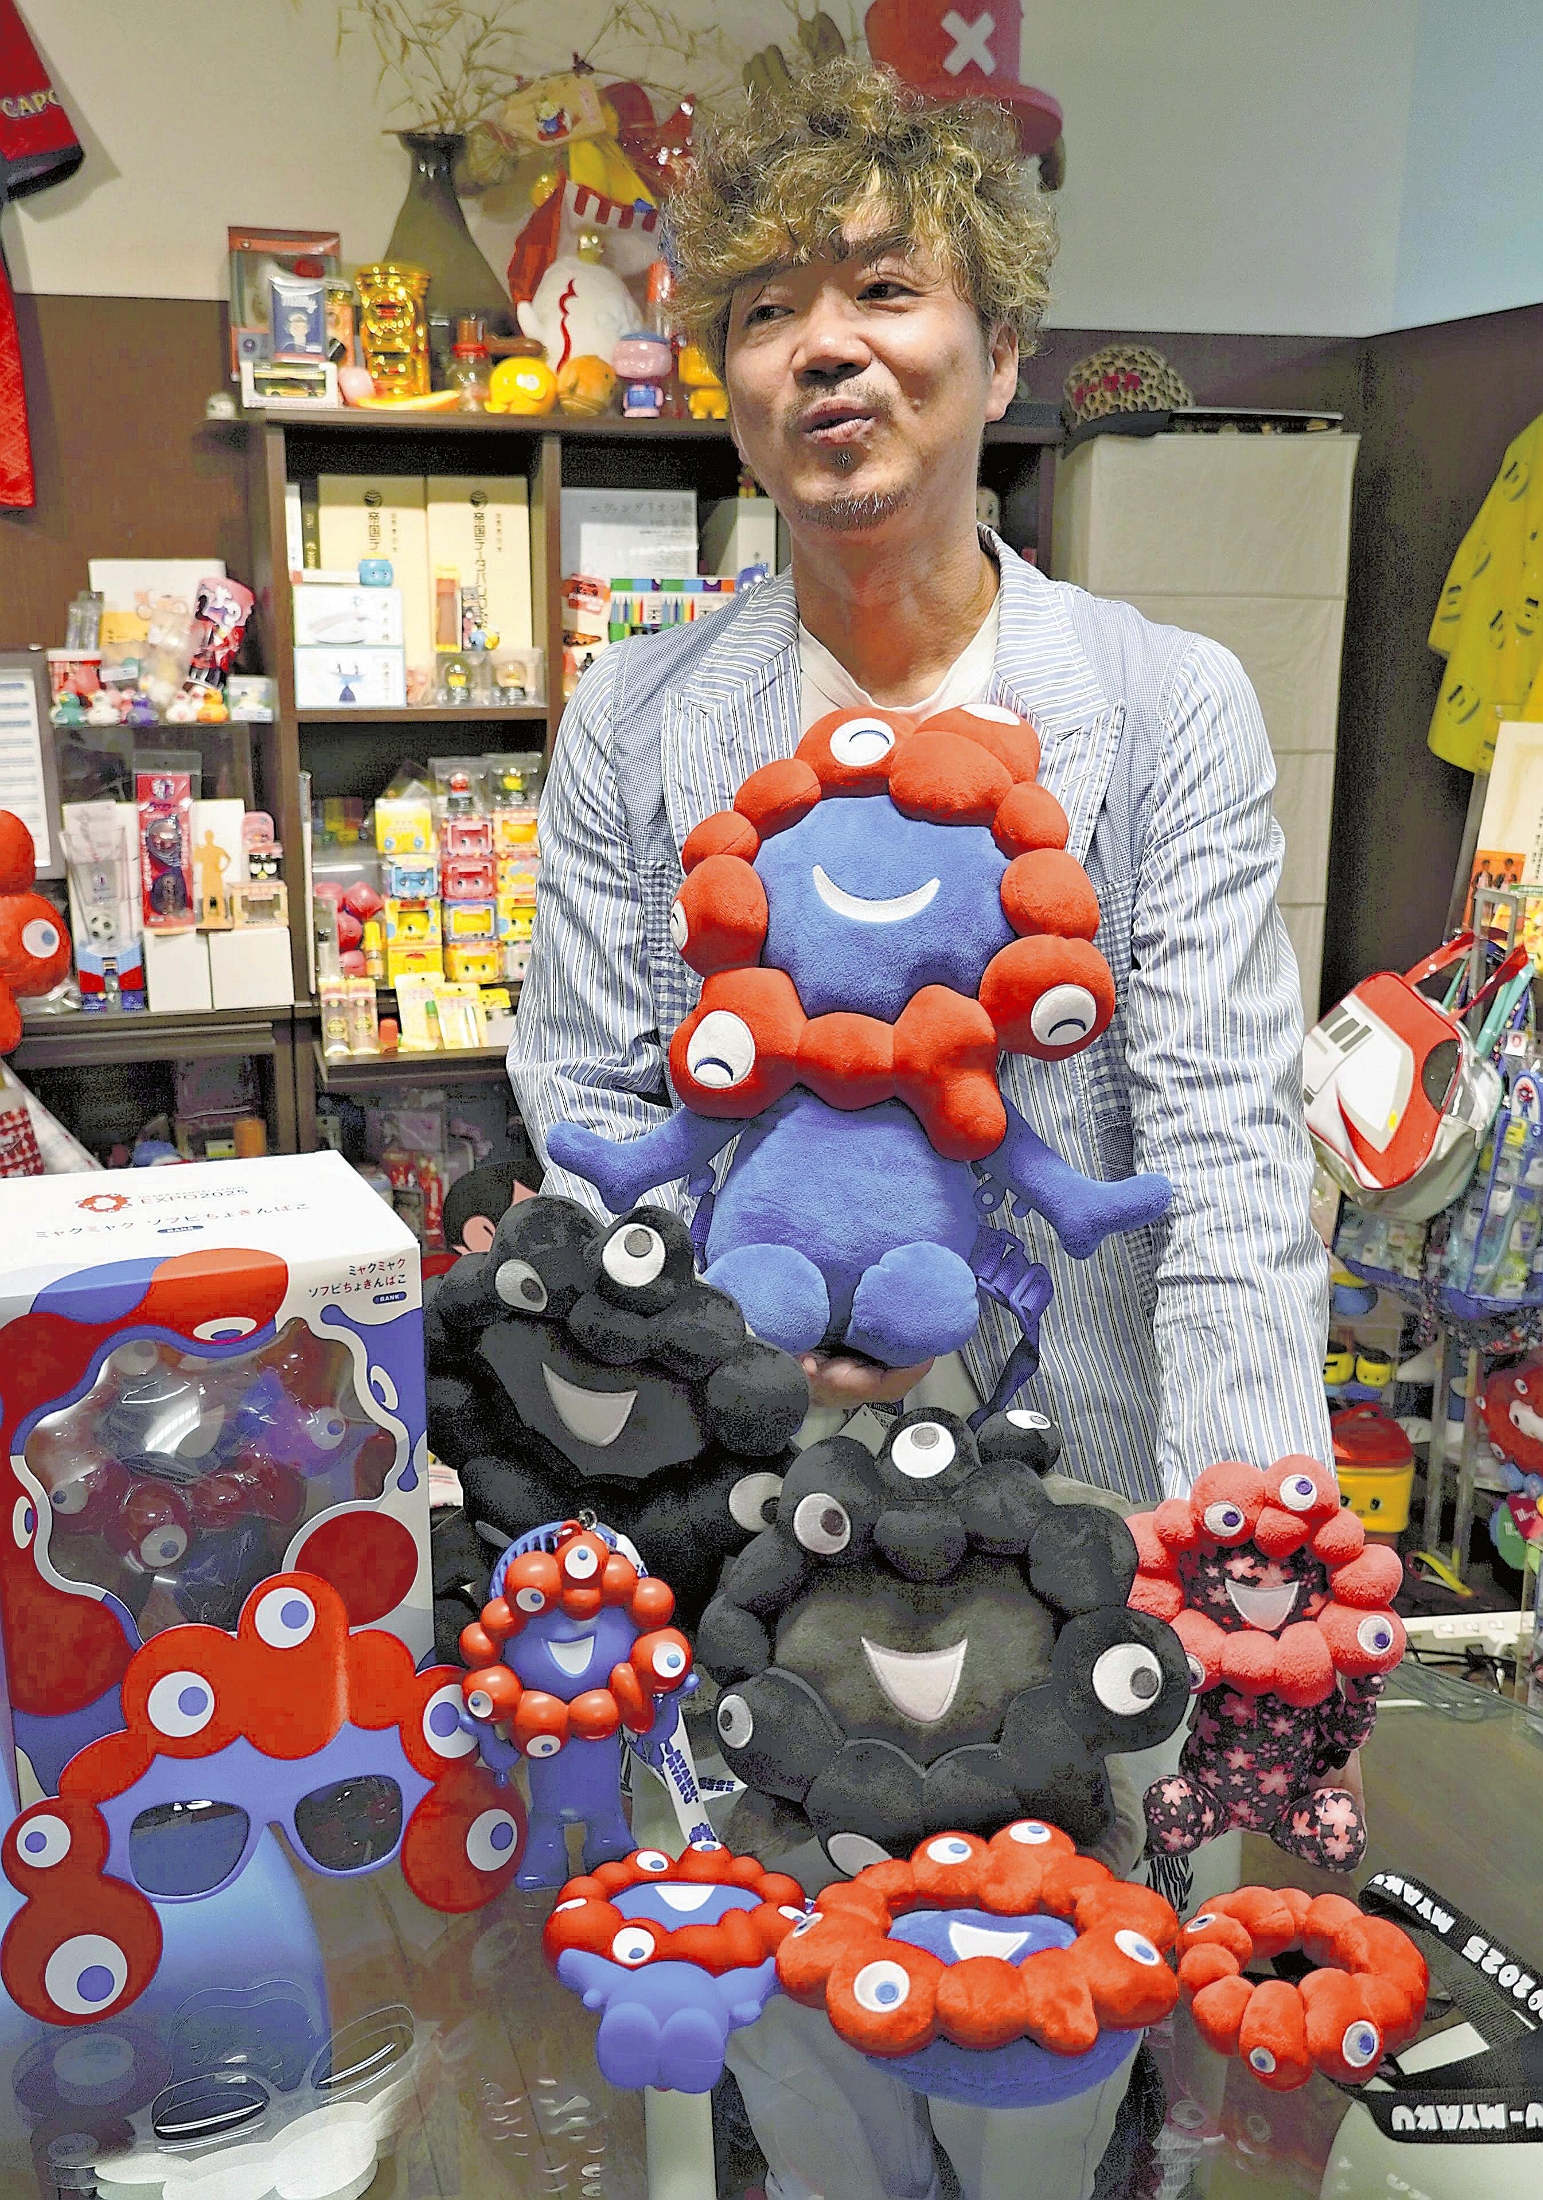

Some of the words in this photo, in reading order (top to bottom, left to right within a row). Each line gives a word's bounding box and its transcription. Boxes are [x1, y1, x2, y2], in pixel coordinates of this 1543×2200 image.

[308, 1273, 407, 1298] ソフビちょきんばこ
[379, 1293, 401, 1303] BANK
